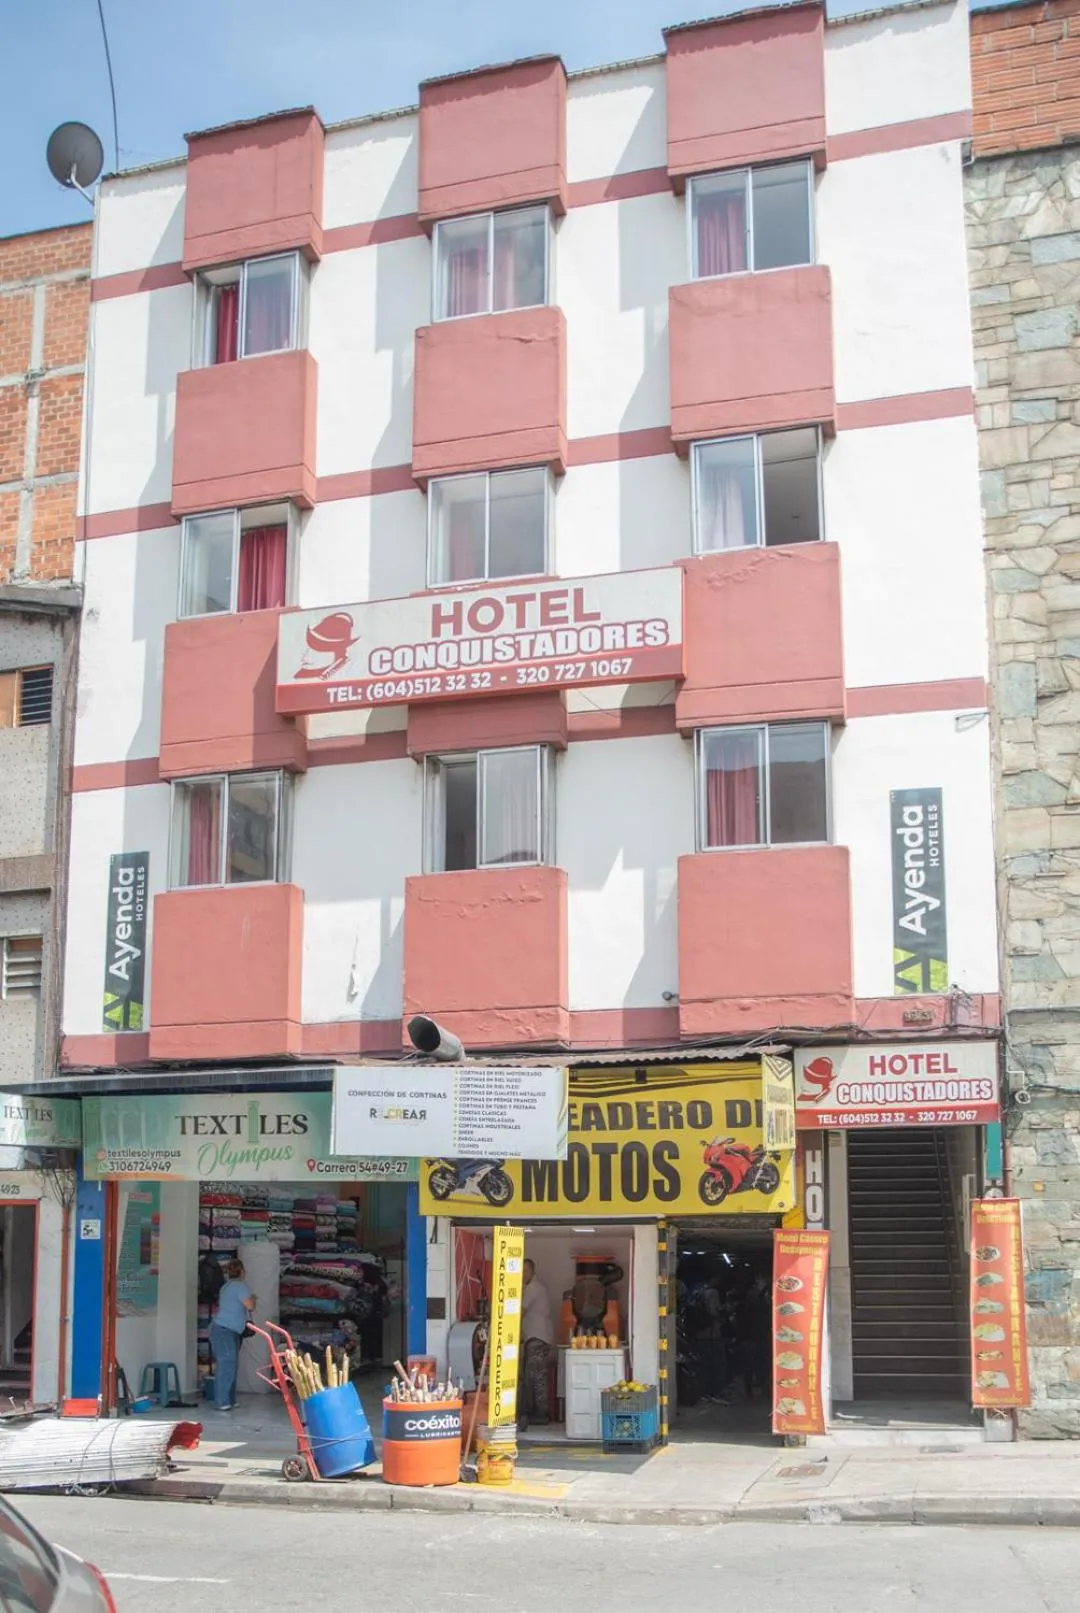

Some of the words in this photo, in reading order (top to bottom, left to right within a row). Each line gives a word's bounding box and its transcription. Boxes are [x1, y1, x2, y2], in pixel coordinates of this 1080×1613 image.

[431, 587, 602, 638] HOTEL
[368, 618, 669, 676] CONQUISTADORES
[327, 685, 362, 704] TEL:
[366, 678, 441, 701] (604)512
[445, 675, 466, 693] 32
[471, 671, 491, 690] 32
[516, 666, 548, 685] 320
[555, 662, 584, 681] 727
[589, 657, 633, 678] 1067
[928, 804, 939, 867] HOTELES
[136, 865, 145, 921] HOTELES
[896, 804, 940, 936] Ayenda
[109, 867, 141, 980] Ayenda
[869, 1053, 958, 1076] HOTEL
[837, 1079, 993, 1104] CONQUISTADORES
[818, 1114, 837, 1124] TEL:
[839, 1112, 879, 1124] (604)512
[881, 1112, 893, 1122] 32
[894, 1112, 905, 1122] 32
[918, 1111, 935, 1122] 320
[937, 1110, 953, 1121] 727
[956, 1110, 978, 1121] 1067
[107, 1148, 181, 1159] textilesolympus
[109, 1161, 171, 1172] 3106724949
[197, 1139, 293, 1175] Olympus
[317, 1162, 356, 1173] Carrera
[521, 1140, 681, 1202] MOTOS
[494, 1240, 506, 1416] PARQUEADERO
[807, 1257, 823, 1420] RESTAURANTE
[404, 1414, 461, 1431] coéxito
